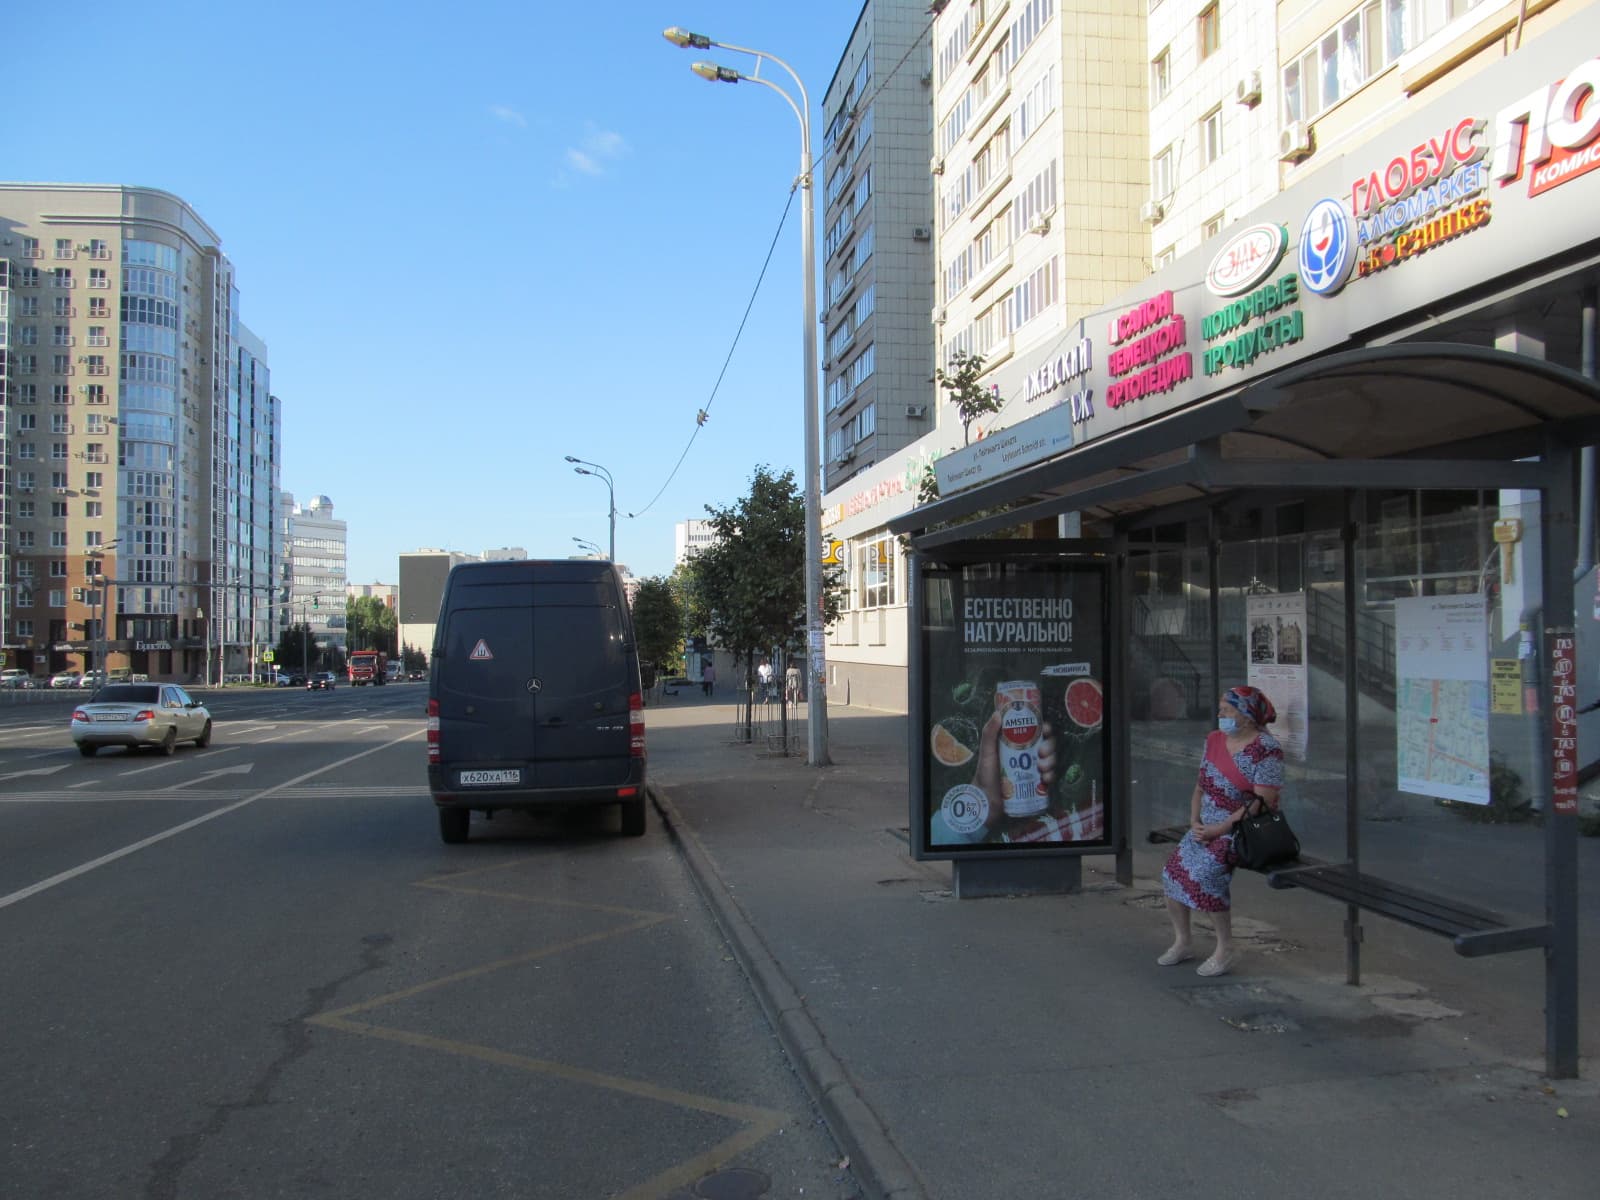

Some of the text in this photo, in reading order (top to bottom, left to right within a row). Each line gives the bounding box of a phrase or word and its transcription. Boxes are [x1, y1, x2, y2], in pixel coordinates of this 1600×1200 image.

[1352, 116, 1484, 217] ГЛОБУС
[1358, 162, 1484, 244] АЛКОМАРКЕТ
[1118, 290, 1174, 341] САЛОН
[1202, 273, 1298, 340] МОЛОЧНЫЕ
[1023, 337, 1092, 402] ИЖЕВСКИЙ
[1108, 314, 1186, 377] НЕМЕЦКОЙ
[1203, 310, 1303, 375] ПРОДУКТЫ
[1106, 352, 1192, 408] ОРТОПЕДИИ
[964, 598, 1073, 619] ЕСТЕСТВЕННО
[964, 621, 1073, 643] НАТУРАЛЬНО!
[1005, 717, 1034, 727] AMSTEL
